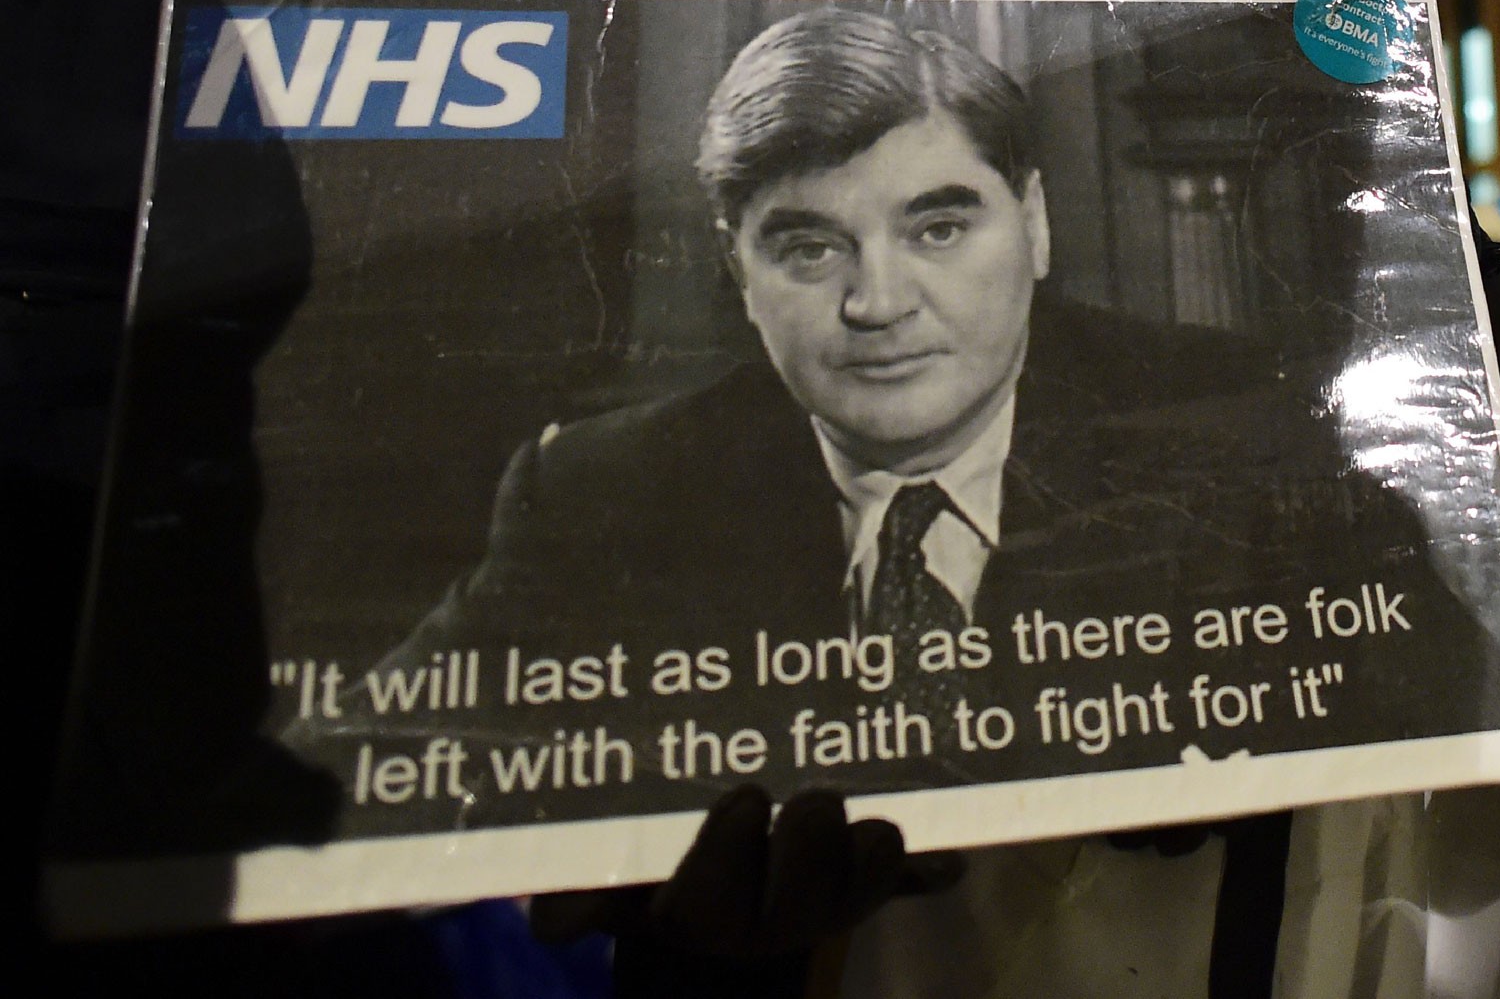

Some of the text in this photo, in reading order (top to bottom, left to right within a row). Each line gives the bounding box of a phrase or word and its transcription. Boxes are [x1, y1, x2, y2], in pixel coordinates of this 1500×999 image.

[184, 18, 555, 129] NHS
[1318, 32, 1366, 60] everyone's
[1341, 20, 1379, 48] BMA
[269, 582, 1413, 720] "It will last as long as there are folk
[355, 663, 1345, 804] left with the faith to fight for it"
